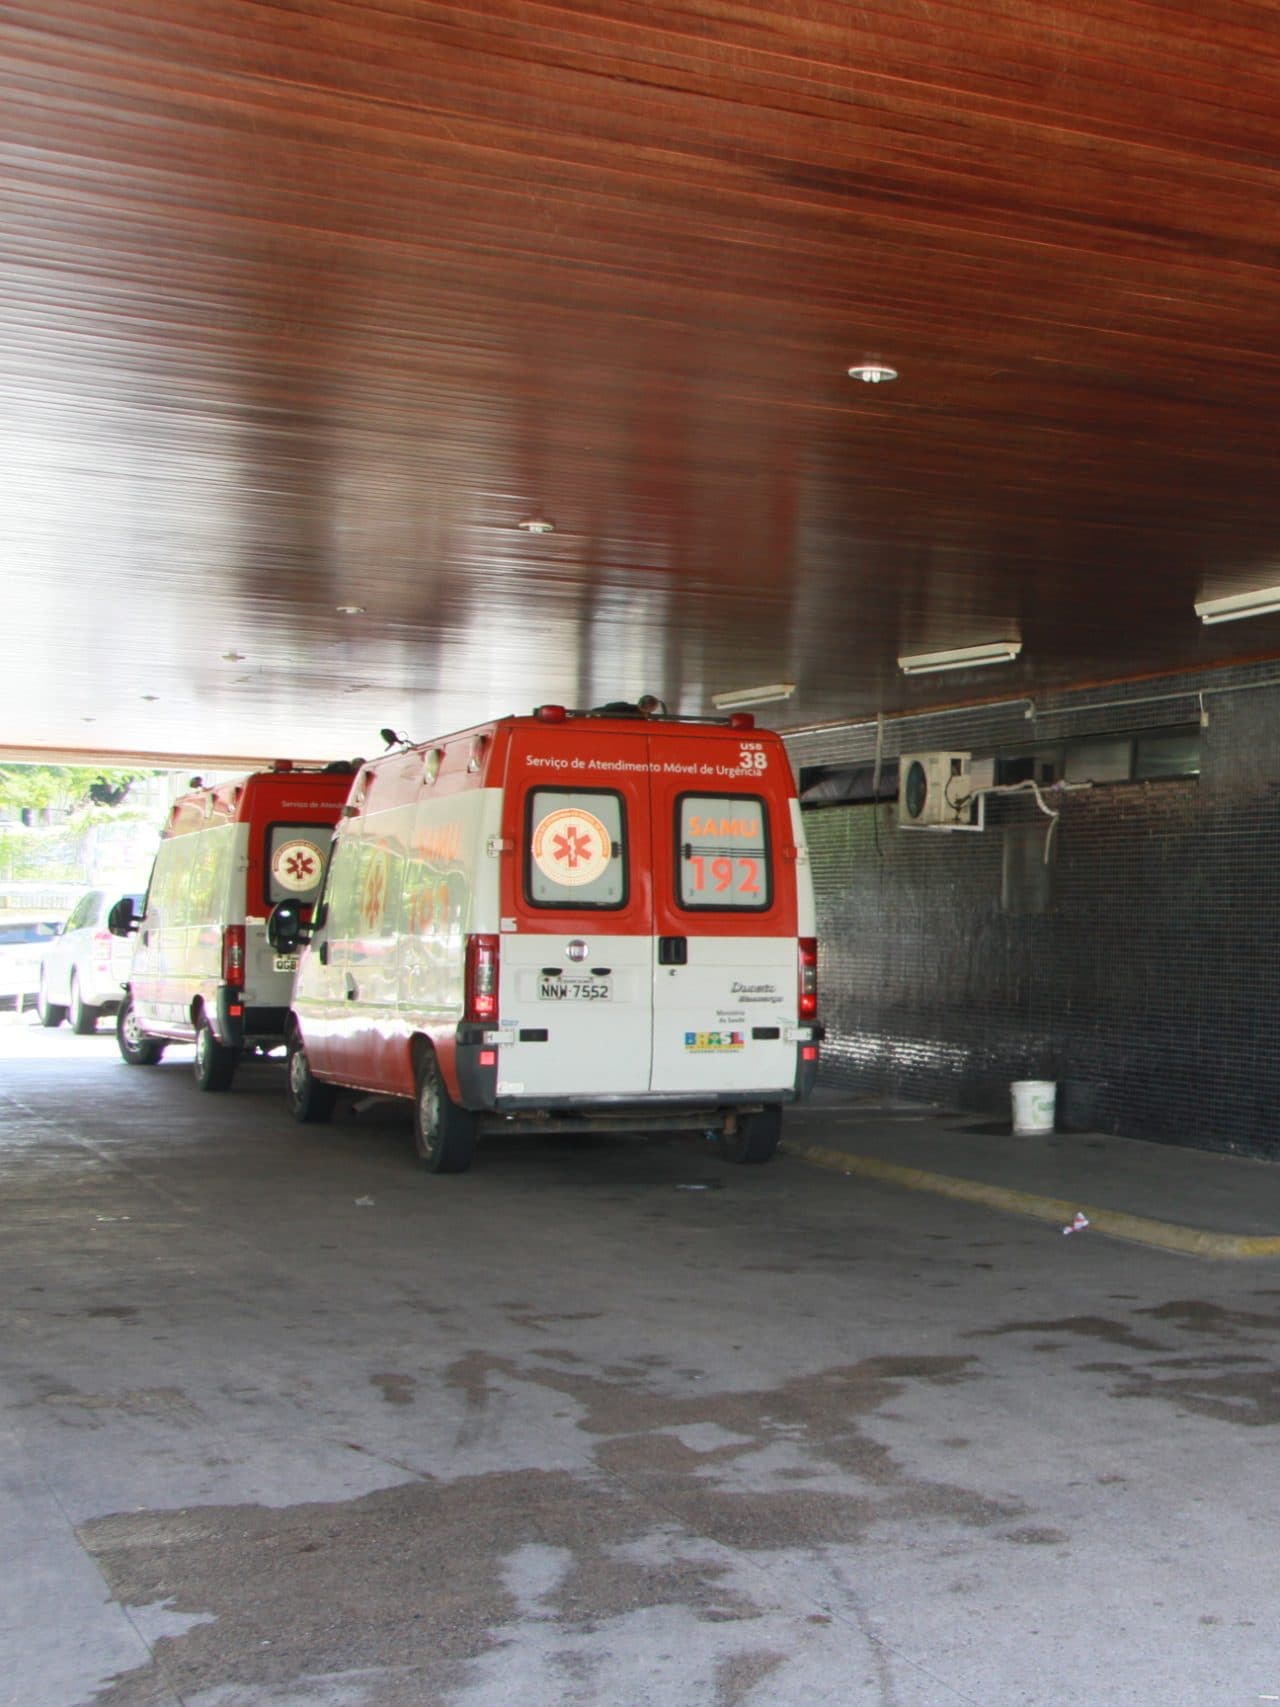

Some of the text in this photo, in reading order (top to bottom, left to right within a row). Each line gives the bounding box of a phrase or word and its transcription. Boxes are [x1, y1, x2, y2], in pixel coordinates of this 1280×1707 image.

[526, 754, 763, 779] Serviço de Atendimento Móvel de Urgência
[740, 751, 767, 769] 38
[688, 815, 759, 839] SAMU
[689, 856, 761, 893] 192
